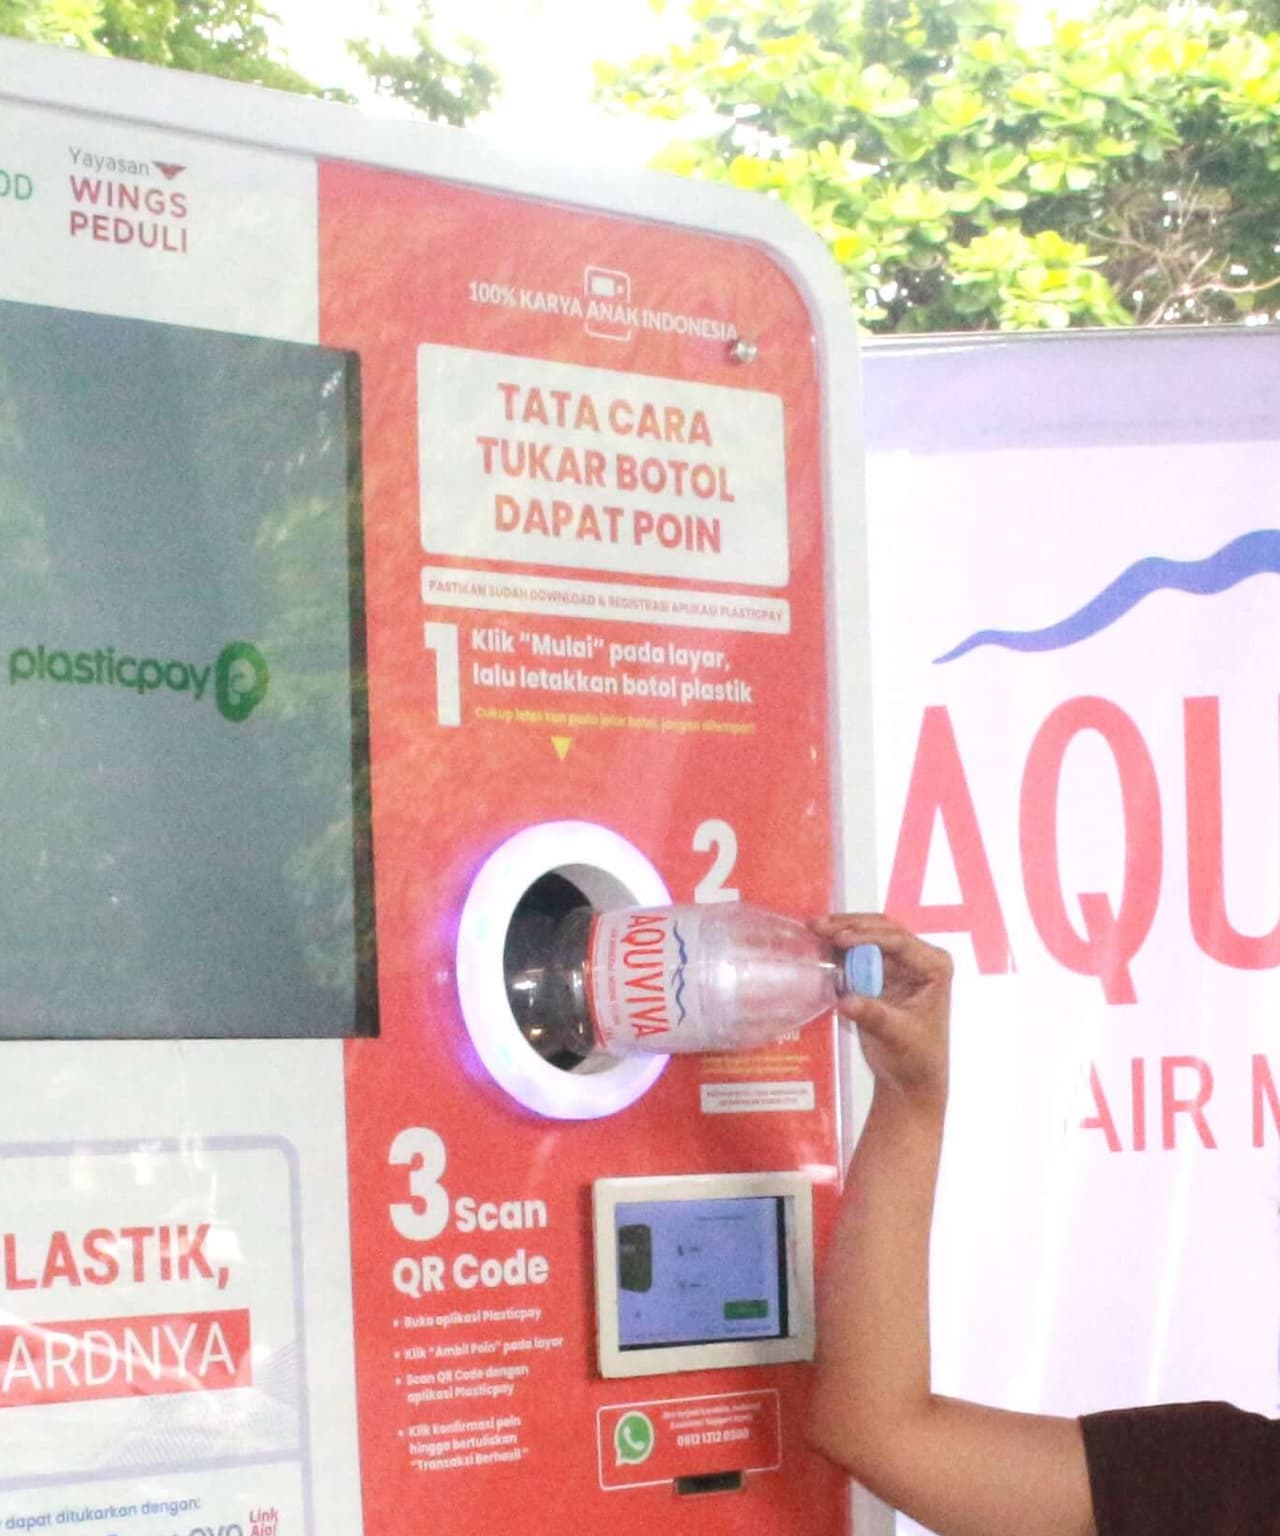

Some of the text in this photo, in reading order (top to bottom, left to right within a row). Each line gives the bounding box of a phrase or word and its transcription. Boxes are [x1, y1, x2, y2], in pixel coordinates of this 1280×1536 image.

[69, 146, 150, 177] Yayasan
[70, 175, 187, 219] WINGS
[70, 211, 187, 253] PEDULI
[468, 281, 737, 341] 100% KARYA ANAK INDONESIA
[498, 382, 713, 448] TATA CARA
[476, 437, 735, 502] TUKAR BOTOL
[494, 494, 722, 553] DAPAT POIN
[8, 645, 211, 700] plasticpay
[424, 621, 461, 727] 1
[471, 628, 515, 653] Klik
[610, 642, 666, 668] pada
[669, 643, 731, 673] layar,
[473, 663, 753, 706] lalu letakkan botol plastik
[692, 818, 740, 905] 2
[620, 914, 673, 1038] AQUVIVA
[1078, 1055, 1218, 1153] AIR
[388, 1126, 548, 1242] 3 Scan
[392, 1249, 549, 1299] QR Code
[436, 1311, 482, 1329] aplikasi
[483, 1306, 542, 1325] Plasticpay
[6, 1515, 52, 1532] dapat
[55, 1503, 137, 1525] ditukarkan
